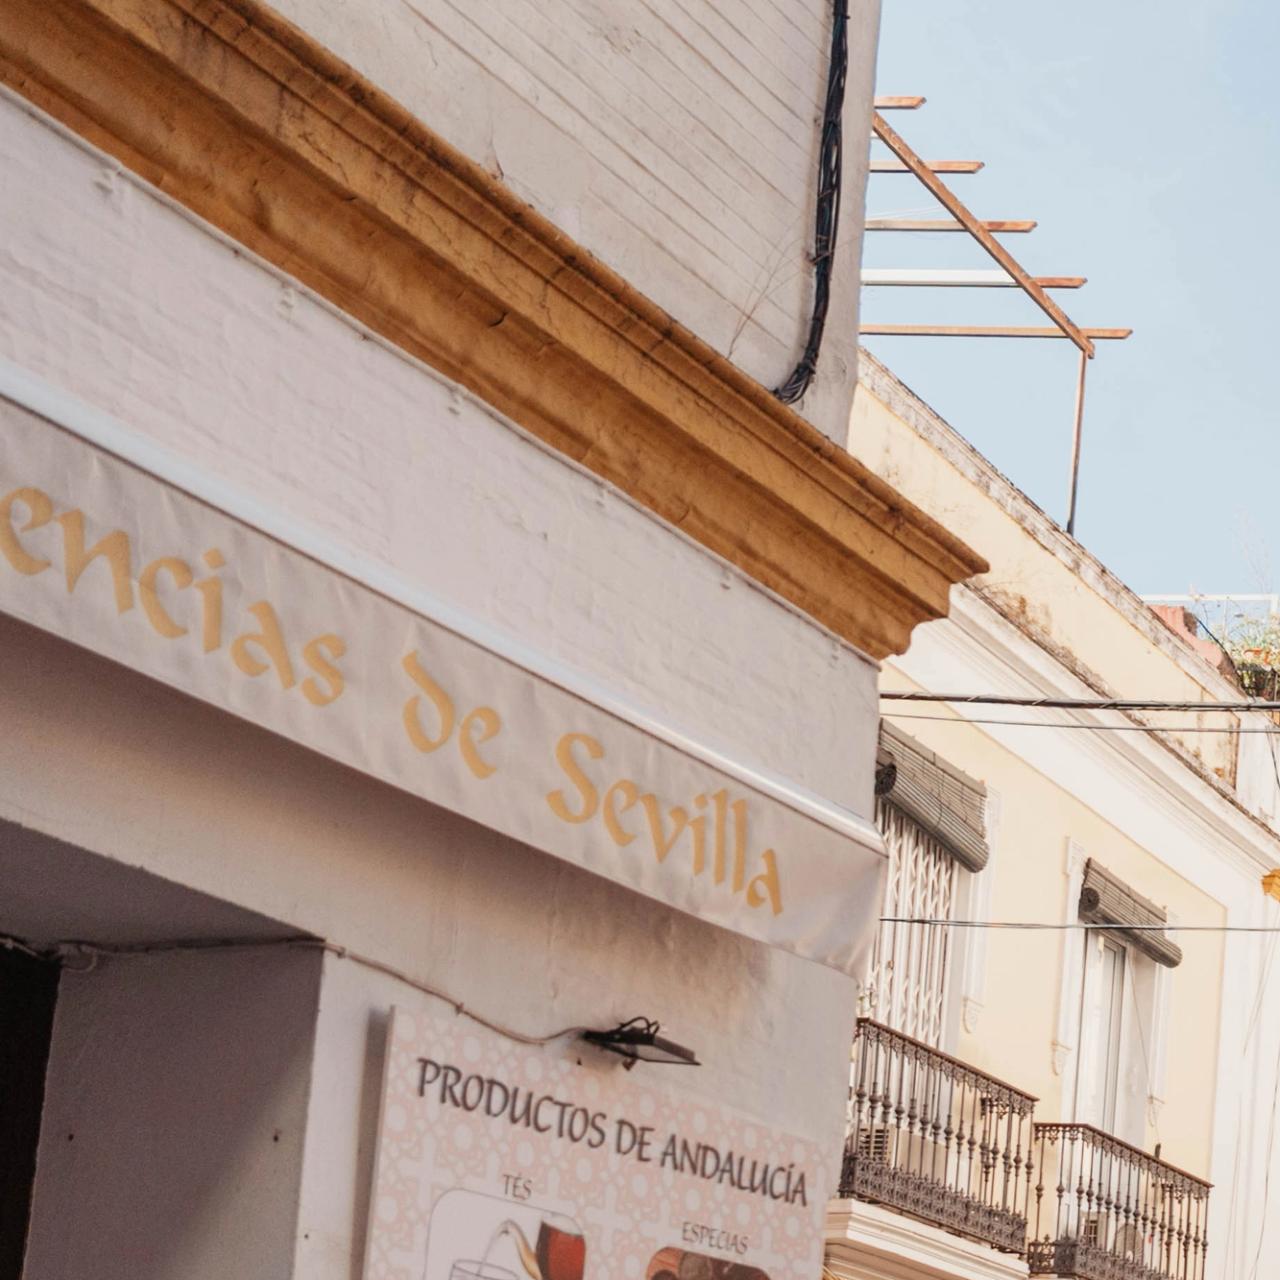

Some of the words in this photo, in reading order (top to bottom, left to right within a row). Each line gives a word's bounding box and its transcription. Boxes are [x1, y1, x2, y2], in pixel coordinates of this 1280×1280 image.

[402, 649, 502, 780] de
[546, 732, 785, 917] Sevilla
[415, 1056, 607, 1150] PRODUCTOS
[615, 1118, 655, 1163] DE
[660, 1133, 809, 1208] ANDALUCÍA
[502, 1171, 534, 1201] TÉS
[681, 1221, 749, 1256] ESPECIAS
